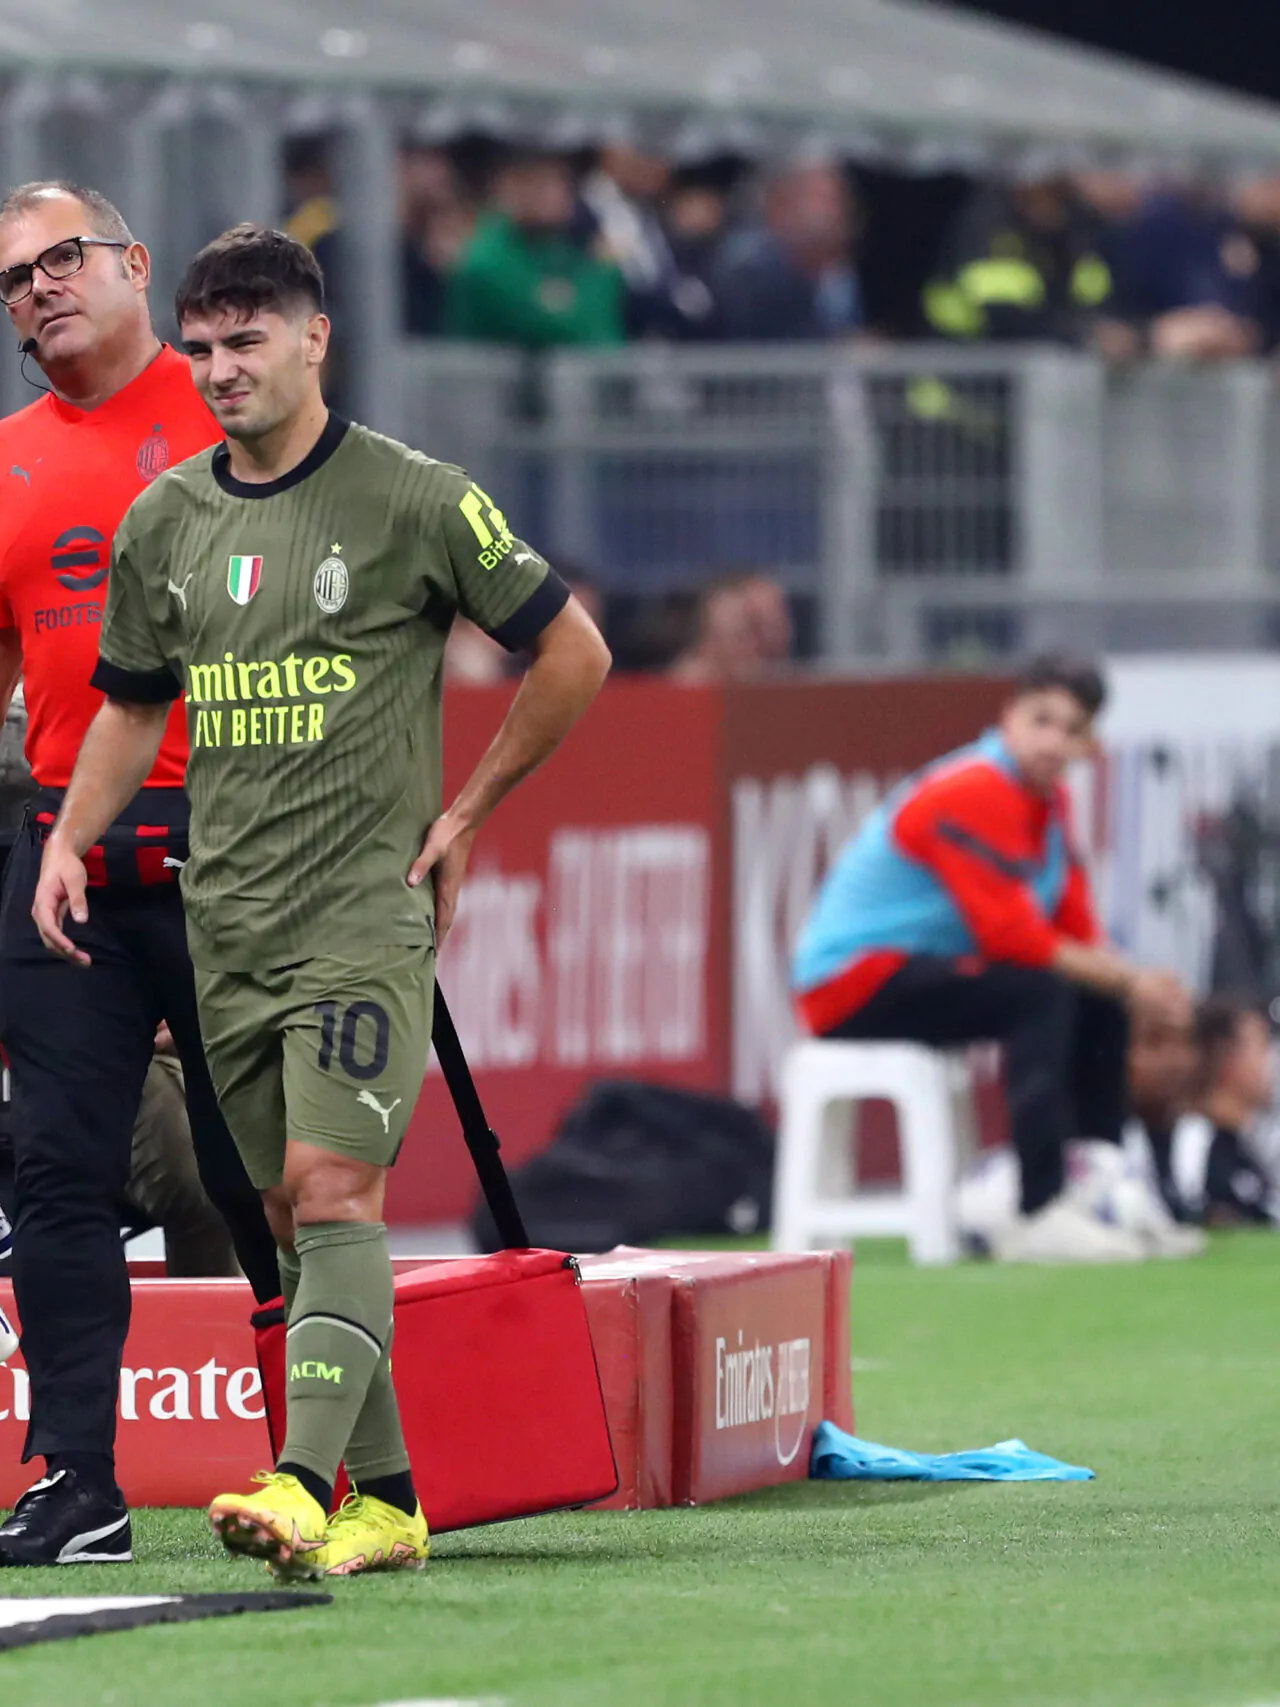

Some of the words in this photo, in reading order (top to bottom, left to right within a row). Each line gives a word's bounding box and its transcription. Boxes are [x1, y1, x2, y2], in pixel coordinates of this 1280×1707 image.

[33, 601, 103, 633] FOOTB
[185, 652, 357, 703] mirates
[196, 711, 222, 747] FLY
[232, 703, 325, 747] BETTER
[314, 1000, 390, 1081] 10
[290, 1361, 344, 1385] ACM
